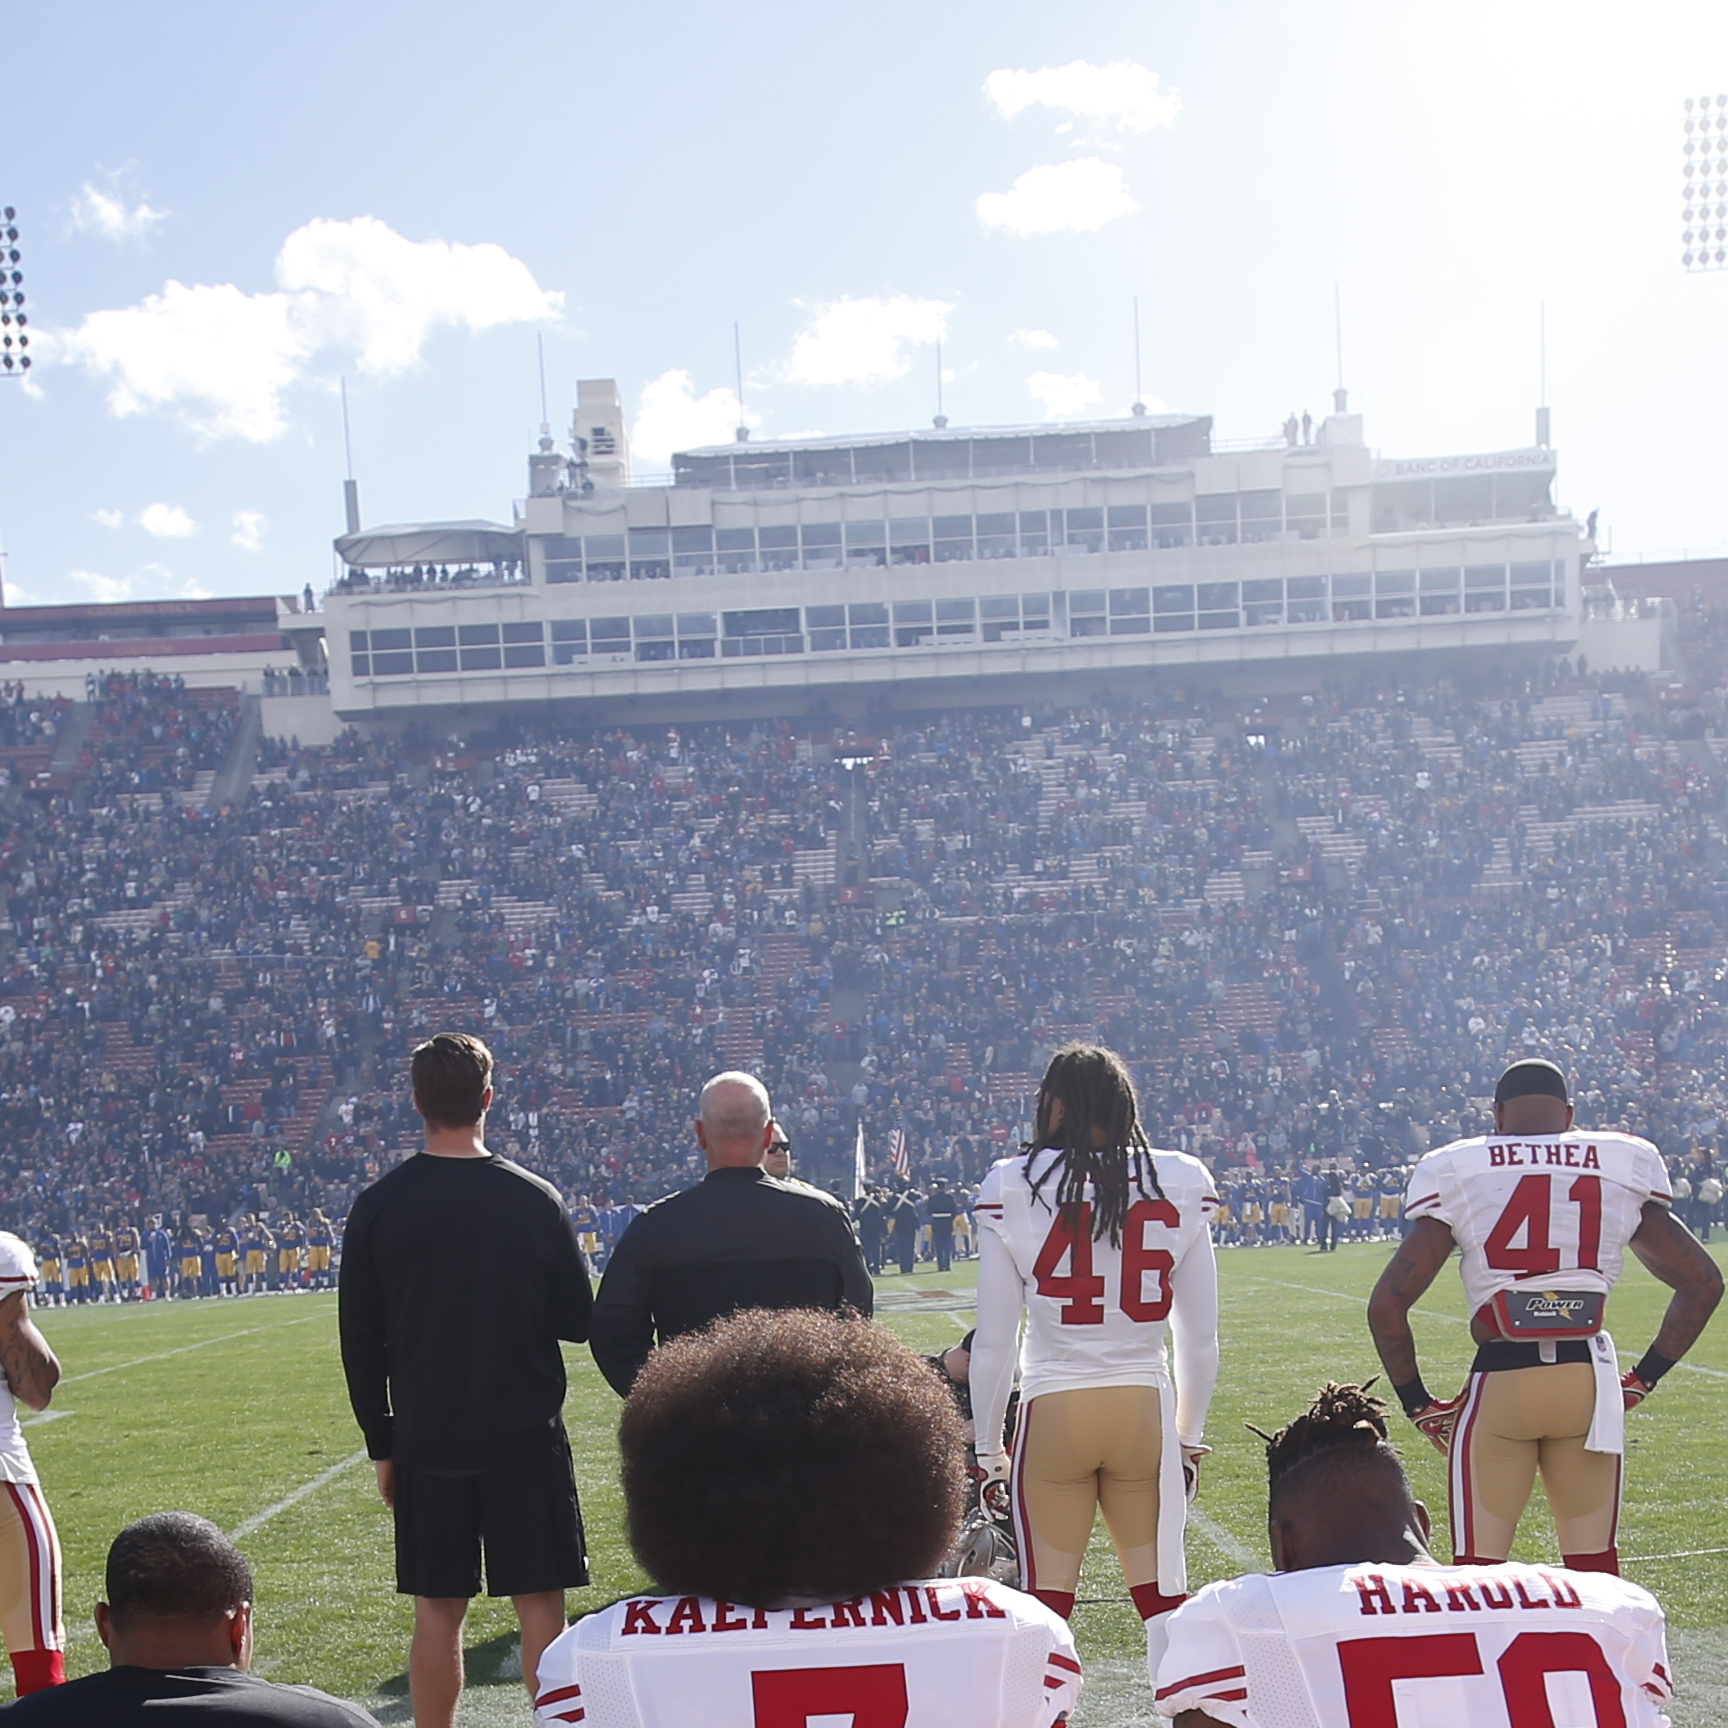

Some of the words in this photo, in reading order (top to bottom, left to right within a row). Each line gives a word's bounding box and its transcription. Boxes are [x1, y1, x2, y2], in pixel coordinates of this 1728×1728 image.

[1396, 461, 1436, 475] BANC
[1440, 459, 1460, 472] OF
[1464, 453, 1552, 470] CALIFORNIA
[1488, 1142, 1601, 1169] BETHEA
[1483, 1173, 1603, 1281] 41
[1032, 1198, 1181, 1325] 46
[1350, 1572, 1583, 1615] HAROLD
